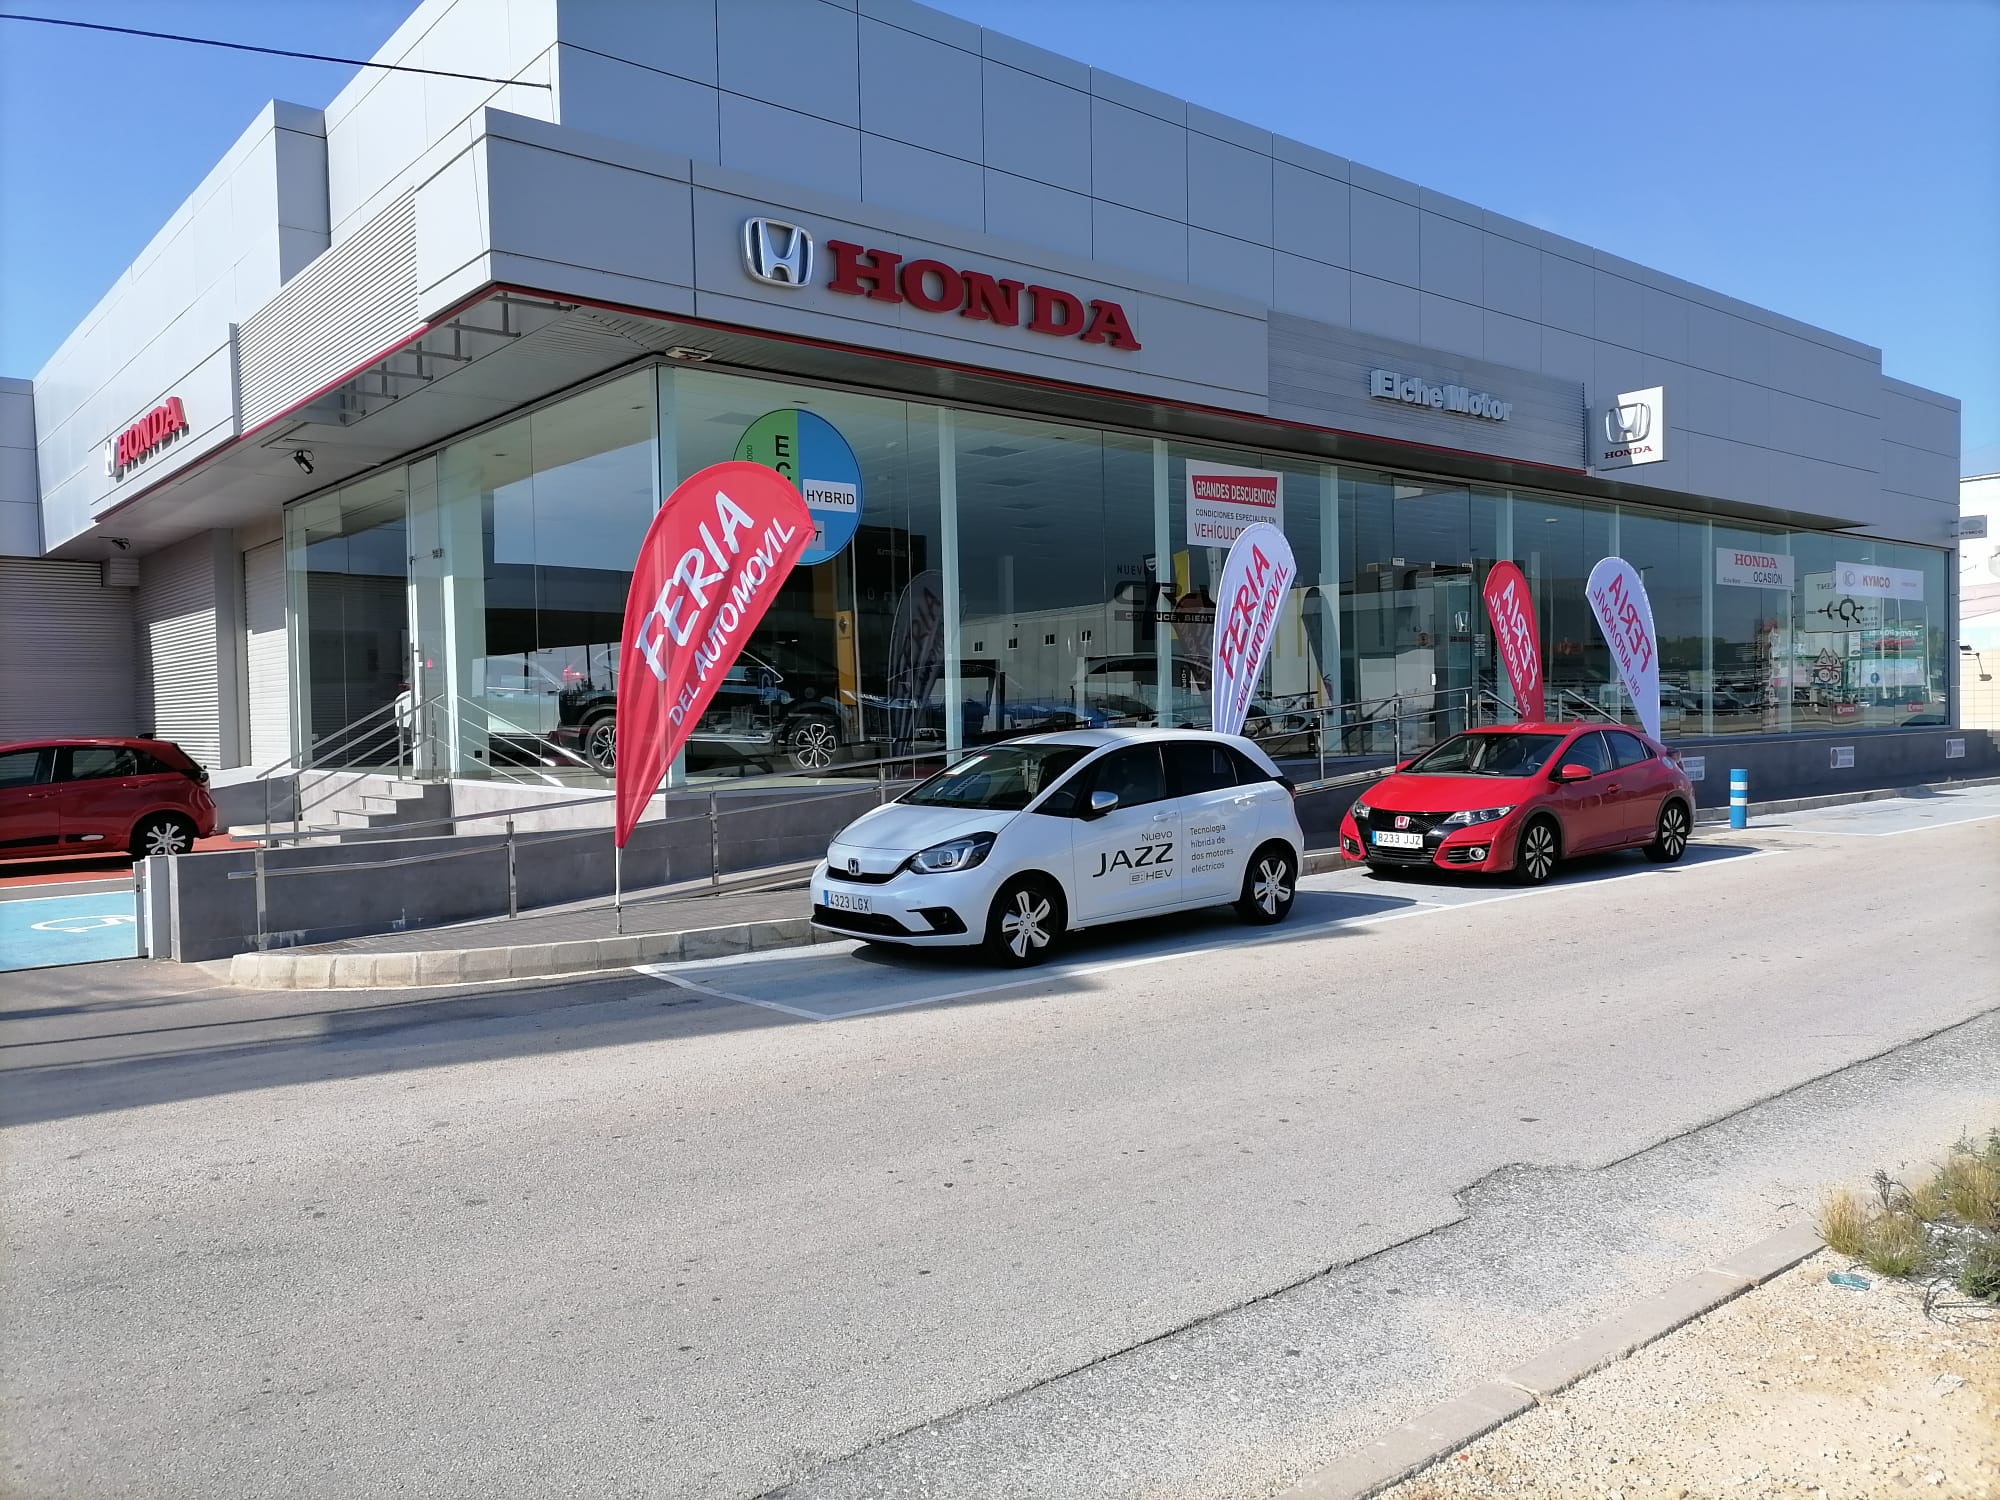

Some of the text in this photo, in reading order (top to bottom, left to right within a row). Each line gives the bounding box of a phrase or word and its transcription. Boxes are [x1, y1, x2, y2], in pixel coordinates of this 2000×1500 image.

[826, 239, 1142, 351] HONDA
[1370, 368, 1513, 421] Elche Motor
[117, 396, 186, 468] HONDA
[1604, 445, 1653, 460] HONDA
[806, 488, 855, 505] HYBRID
[1195, 480, 1276, 505] GRANDES DESCUENTOS
[1195, 508, 1235, 520] CONDICIONES
[1235, 512, 1267, 524] ESPECIALES
[1734, 553, 1777, 569] HONDA
[635, 490, 755, 682] FERIA
[1862, 575, 1891, 589] KYMCO
[1219, 543, 1270, 680] FERIA
[1245, 561, 1288, 678] AUTOMOVIL
[669, 518, 796, 727] DEL AUTOMOVIL
[1141, 830, 1173, 842] Nuevo
[1216, 836, 1226, 844] de
[1378, 833, 1421, 845] 8233 JJZ
[1092, 842, 1173, 878] JAZZ
[1191, 848, 1234, 861] dos motores
[830, 893, 870, 911] 4323 LGX
